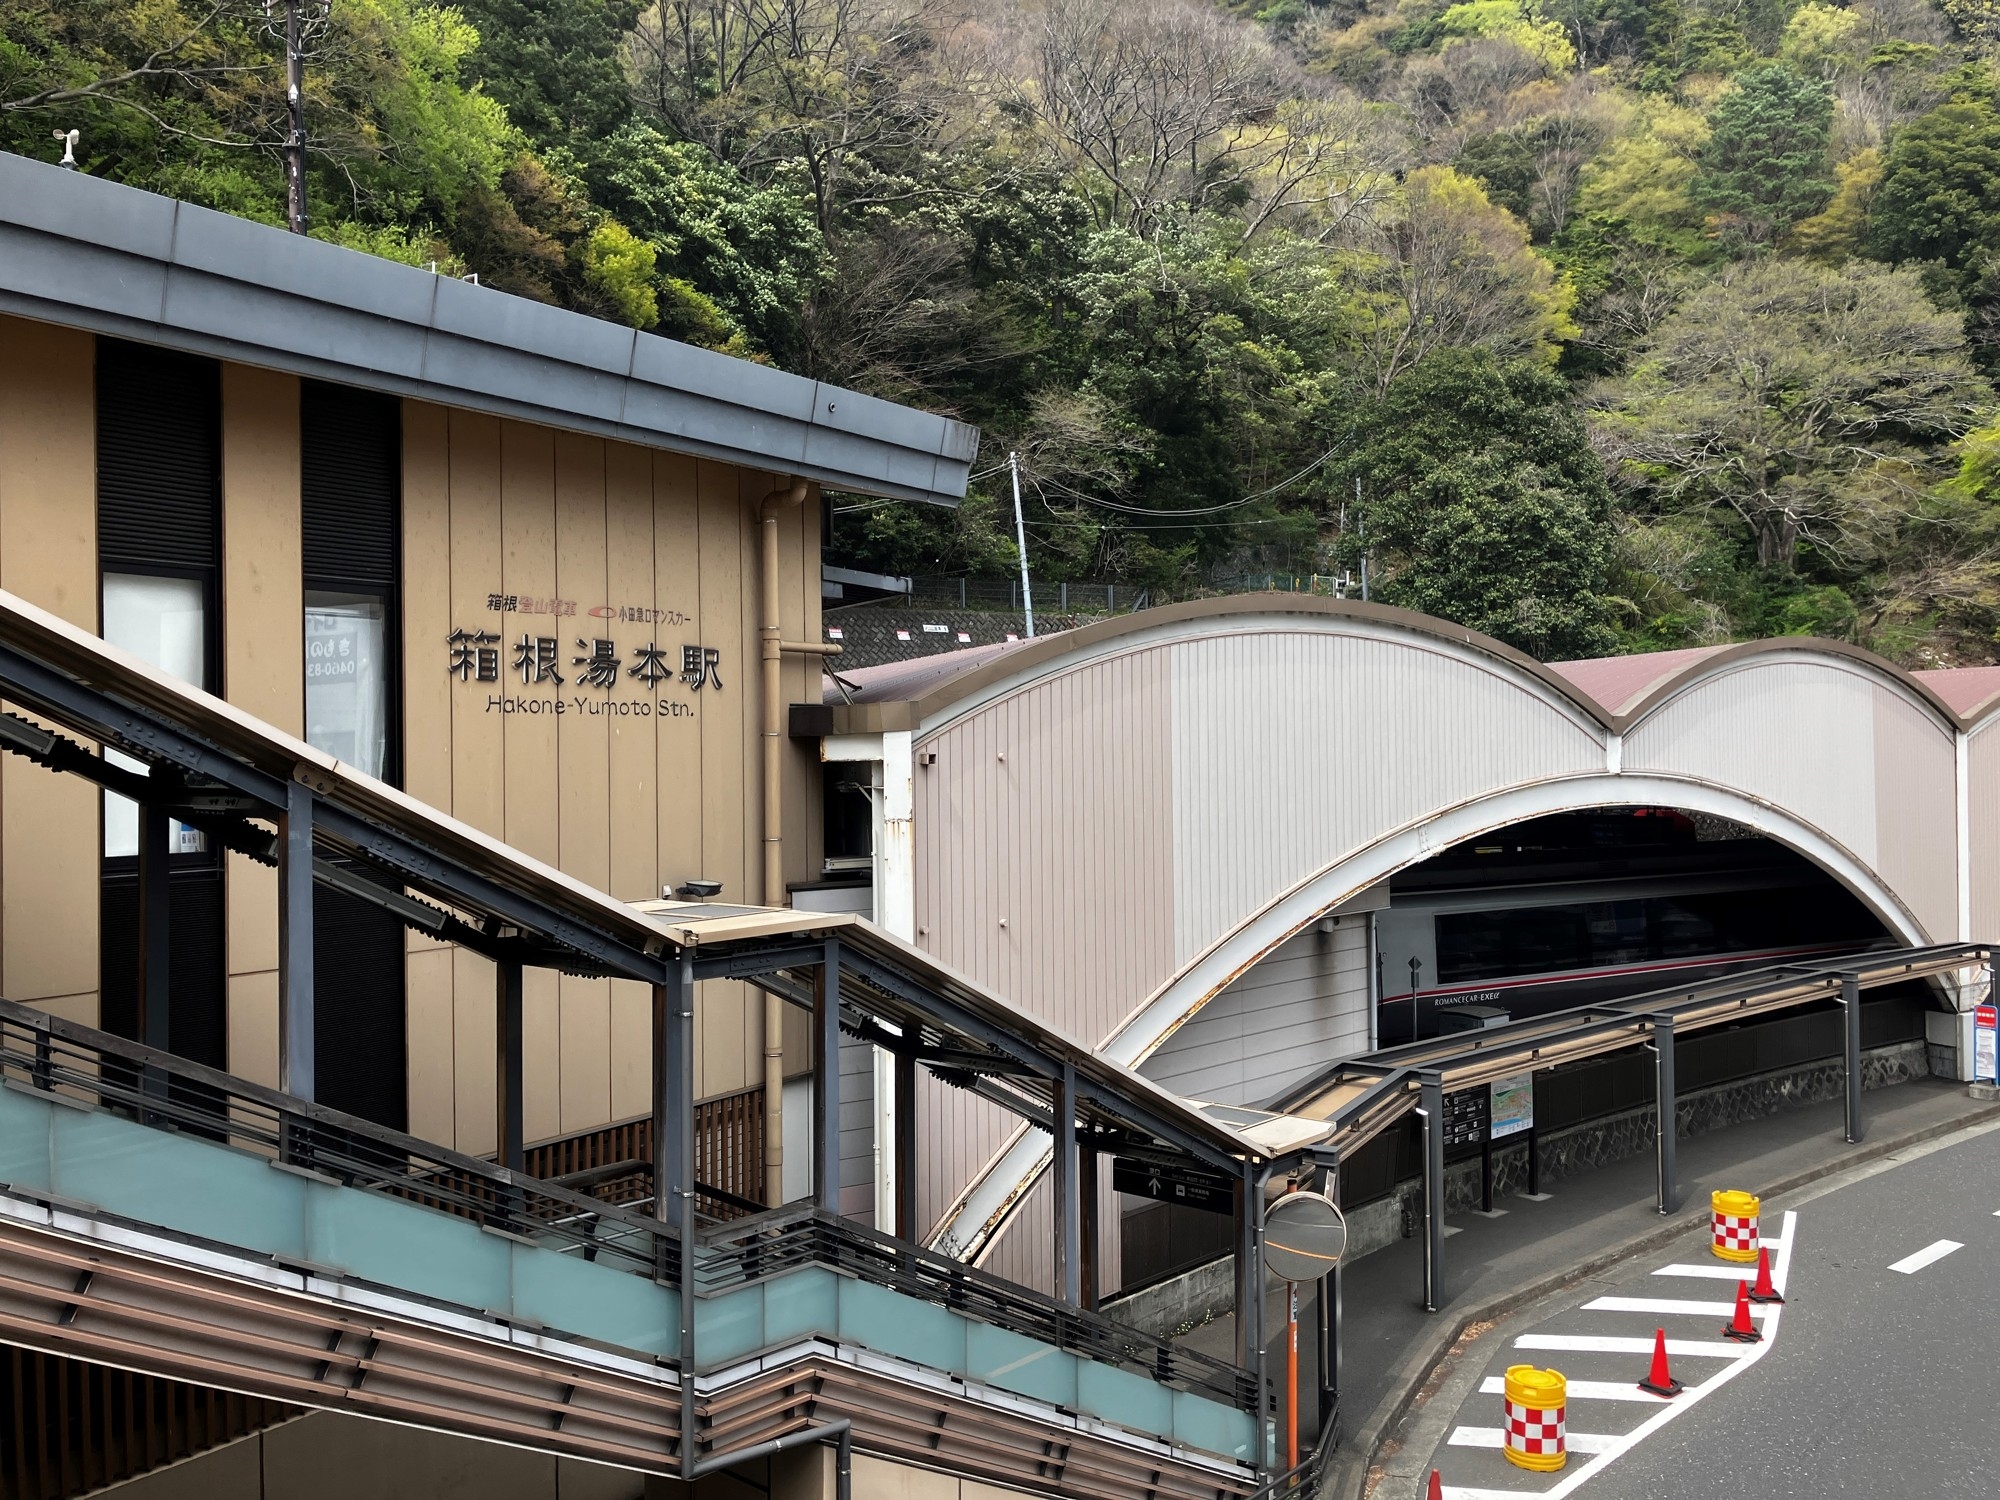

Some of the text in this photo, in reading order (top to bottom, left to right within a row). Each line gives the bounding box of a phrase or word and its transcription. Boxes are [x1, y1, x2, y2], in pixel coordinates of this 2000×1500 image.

[486, 593, 577, 617] 箱根登山電車
[618, 606, 691, 626] 小田急ロマンスカー
[446, 628, 723, 691] 箱根湯本駅
[485, 695, 694, 717] Hakone-Yumoto Stn.
